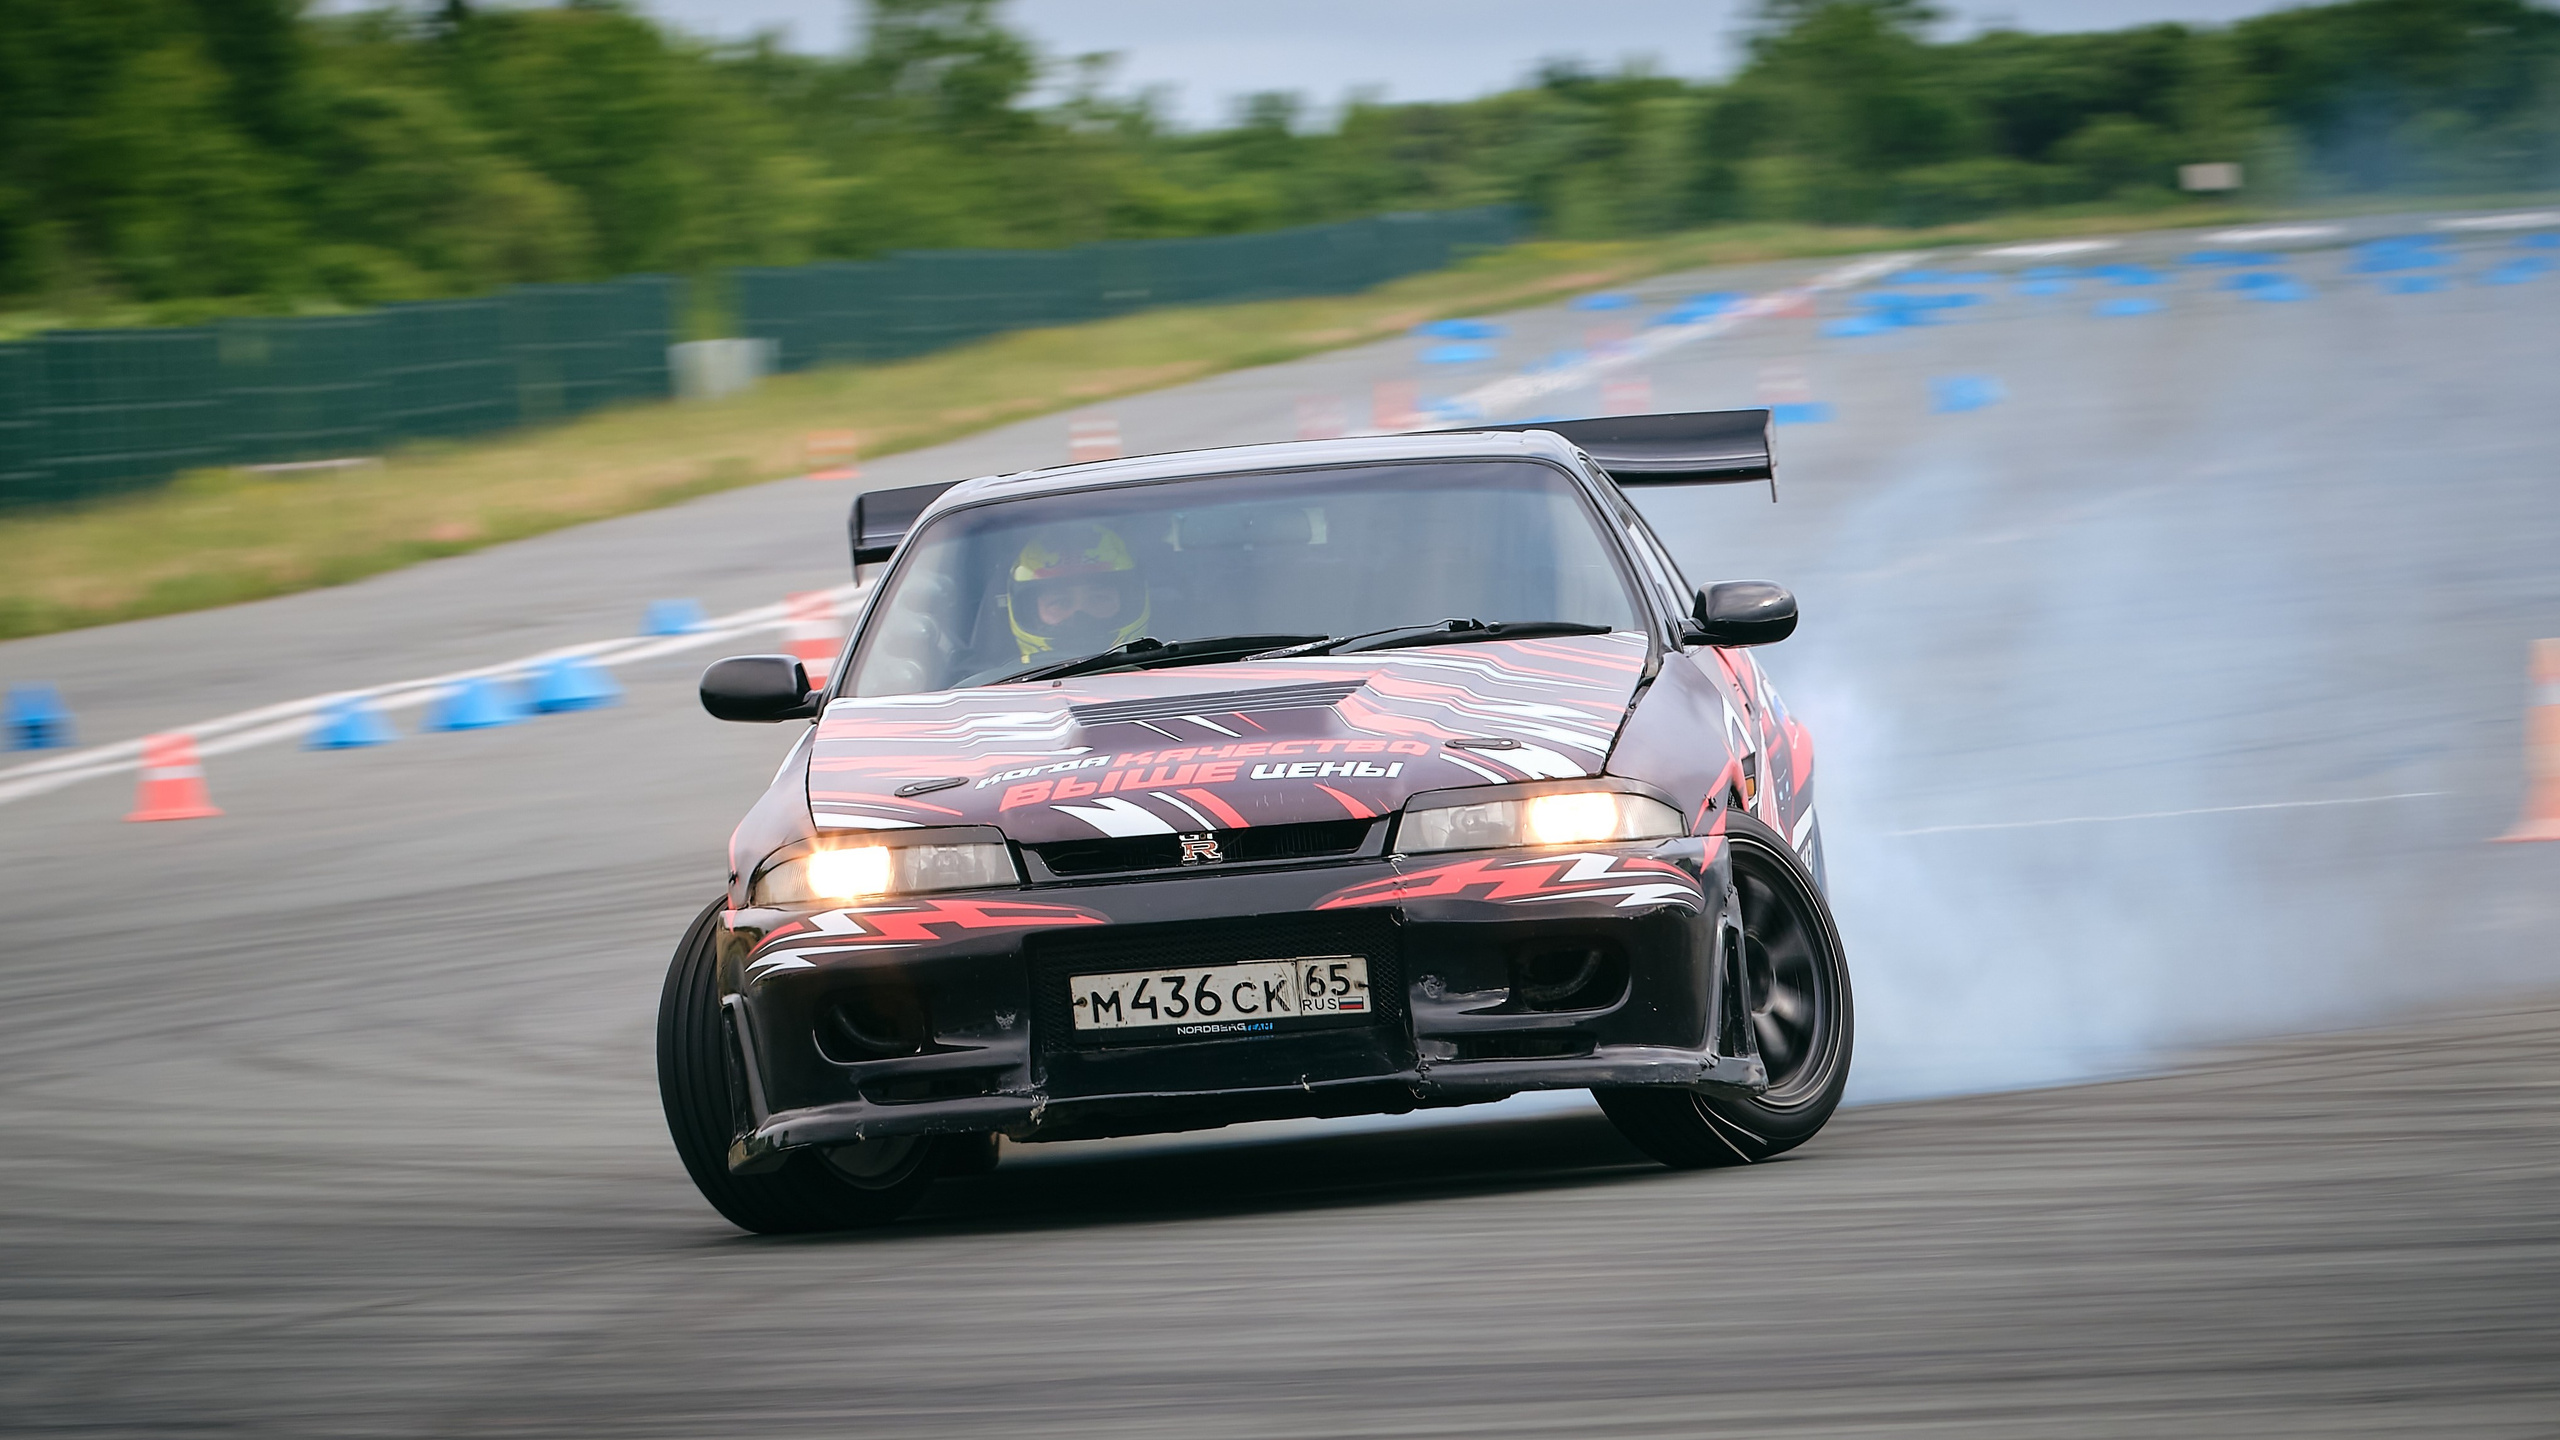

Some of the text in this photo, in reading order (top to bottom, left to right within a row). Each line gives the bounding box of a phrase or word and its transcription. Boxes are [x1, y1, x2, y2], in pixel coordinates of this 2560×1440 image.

[1112, 740, 1431, 768] КАЧЕСТВО
[998, 760, 1404, 812] ВЫШЕ ЦЕНЫ
[1304, 963, 1351, 997] 65
[1302, 997, 1338, 1012] RUS
[1176, 1022, 1246, 1036] NORDBERG
